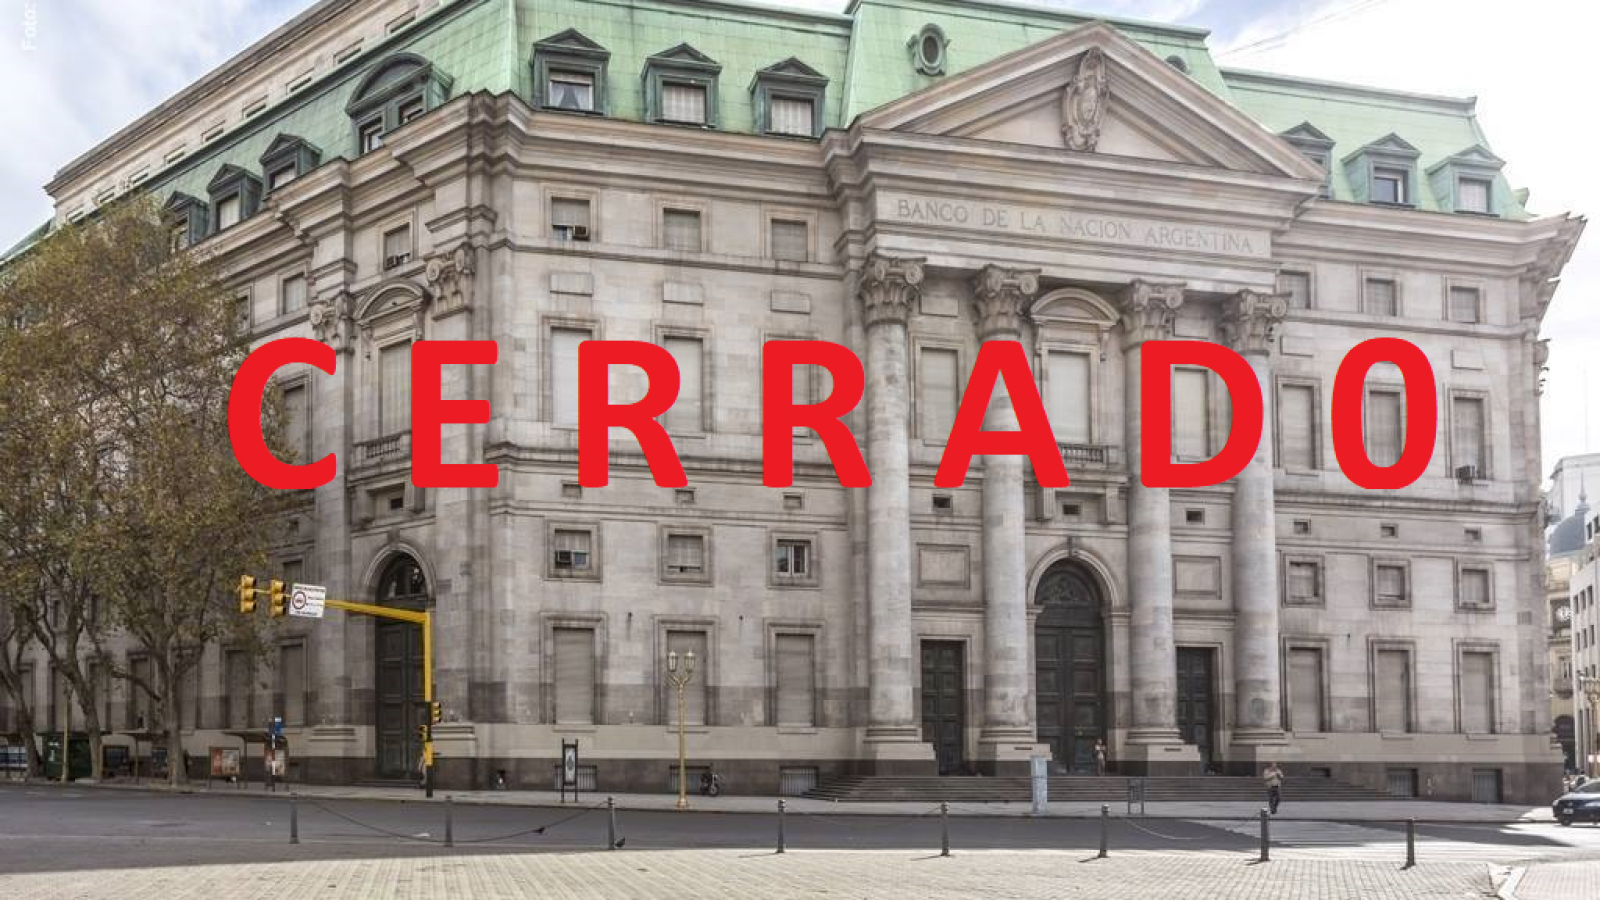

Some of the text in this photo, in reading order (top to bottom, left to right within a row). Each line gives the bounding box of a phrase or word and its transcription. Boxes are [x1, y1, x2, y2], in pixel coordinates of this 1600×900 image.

[897, 199, 1254, 254] BANCO DE LA NACION ARGENTINA
